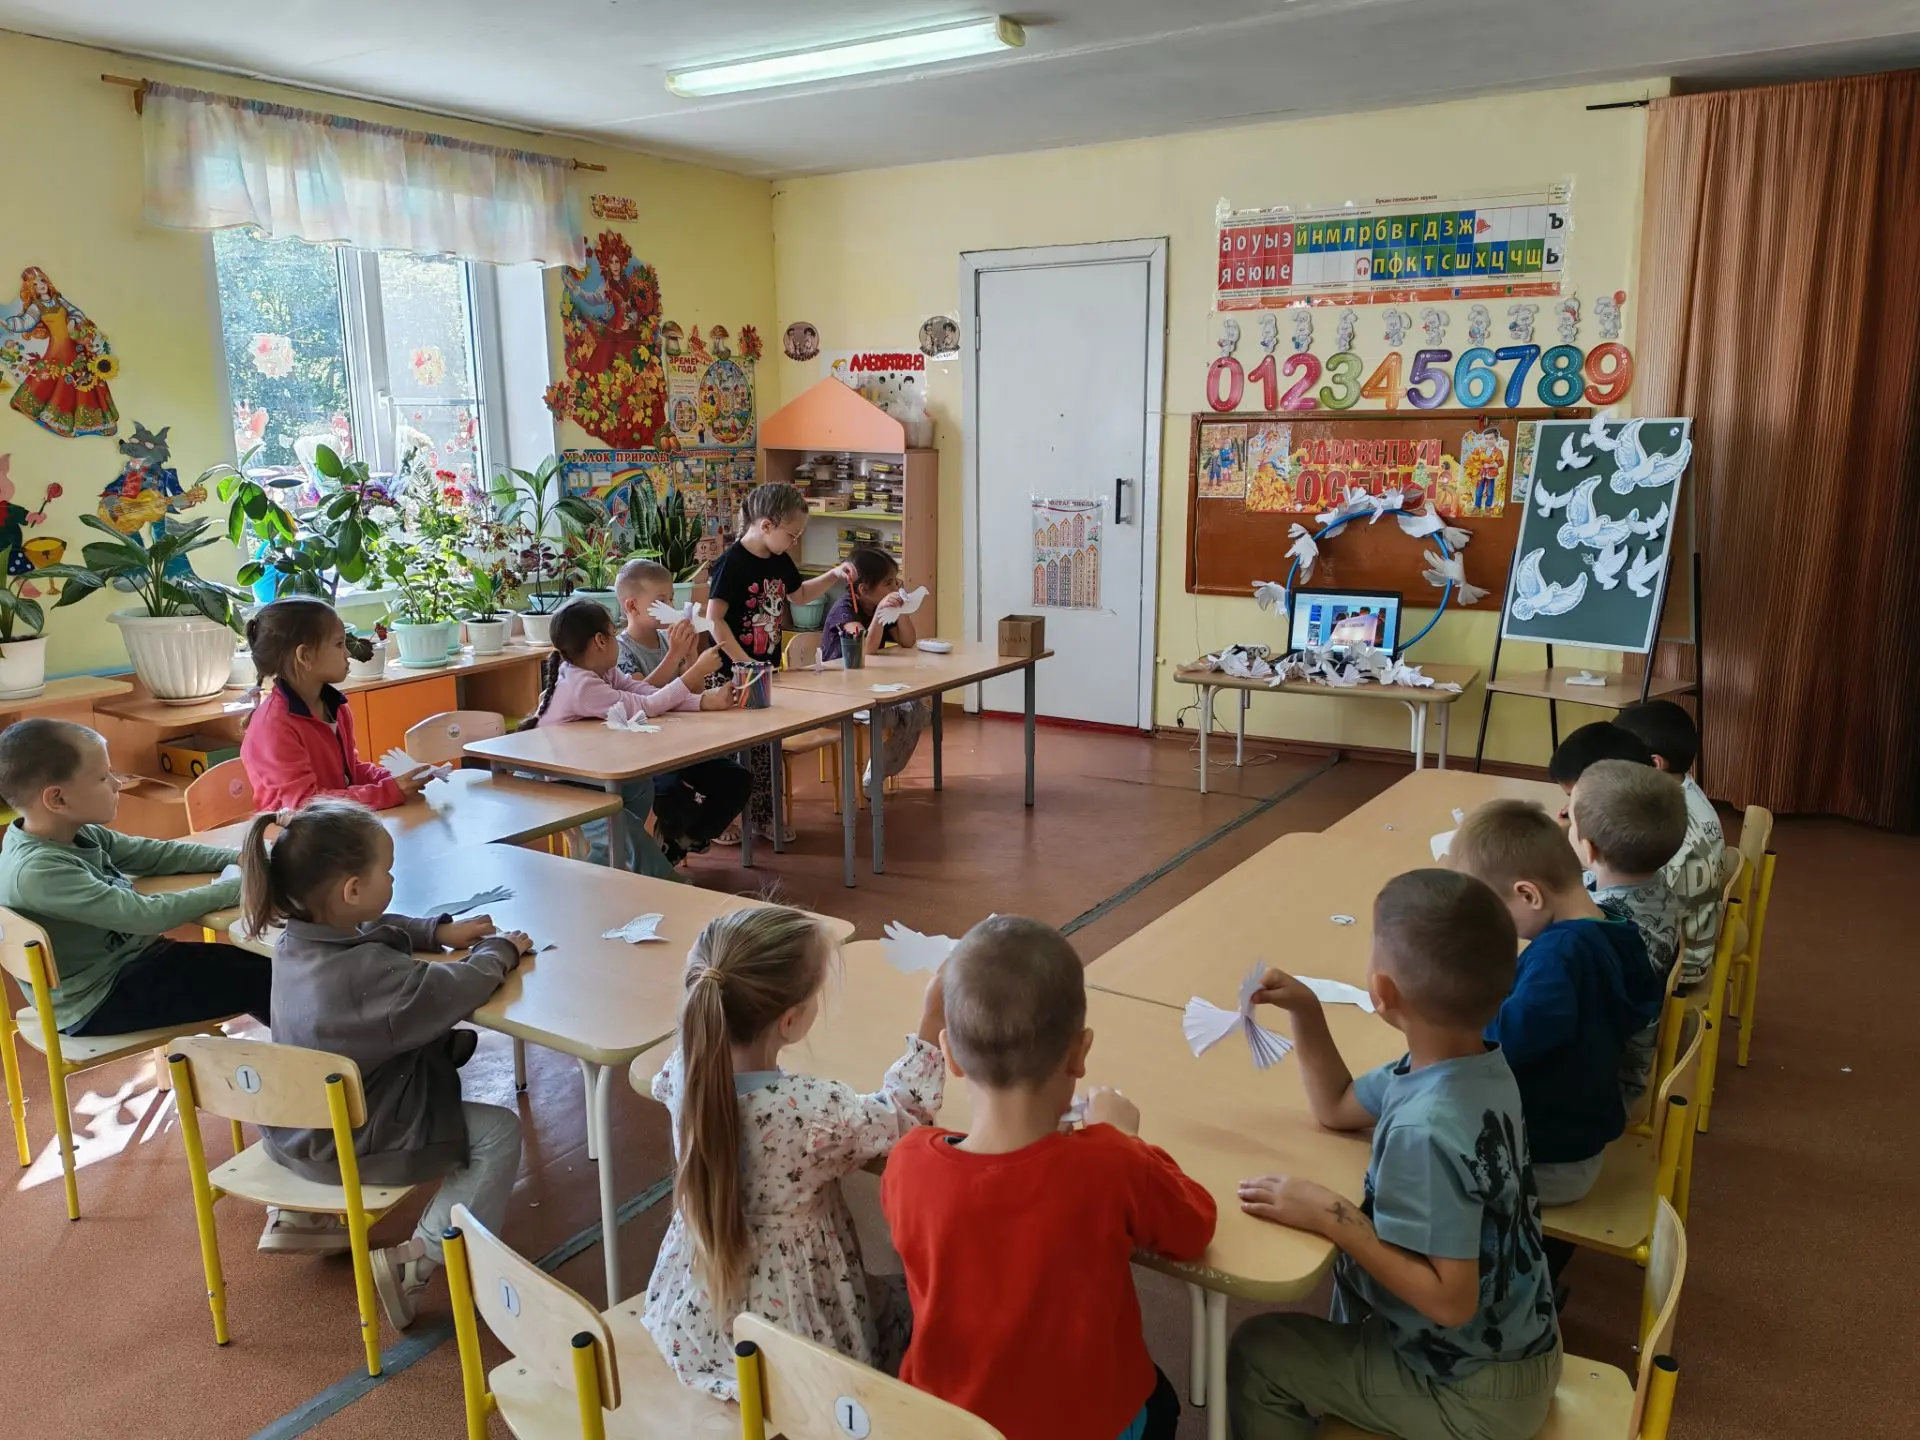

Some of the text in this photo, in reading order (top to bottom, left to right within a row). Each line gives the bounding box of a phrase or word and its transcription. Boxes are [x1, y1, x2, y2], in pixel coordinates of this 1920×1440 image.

[615, 452, 670, 464] ПРИРОДЫ
[1300, 438, 1442, 467] ЗДРАВСТВУЙ
[243, 1070, 251, 1089] 1
[503, 1285, 511, 1309] 1
[845, 1404, 855, 1432] 1
